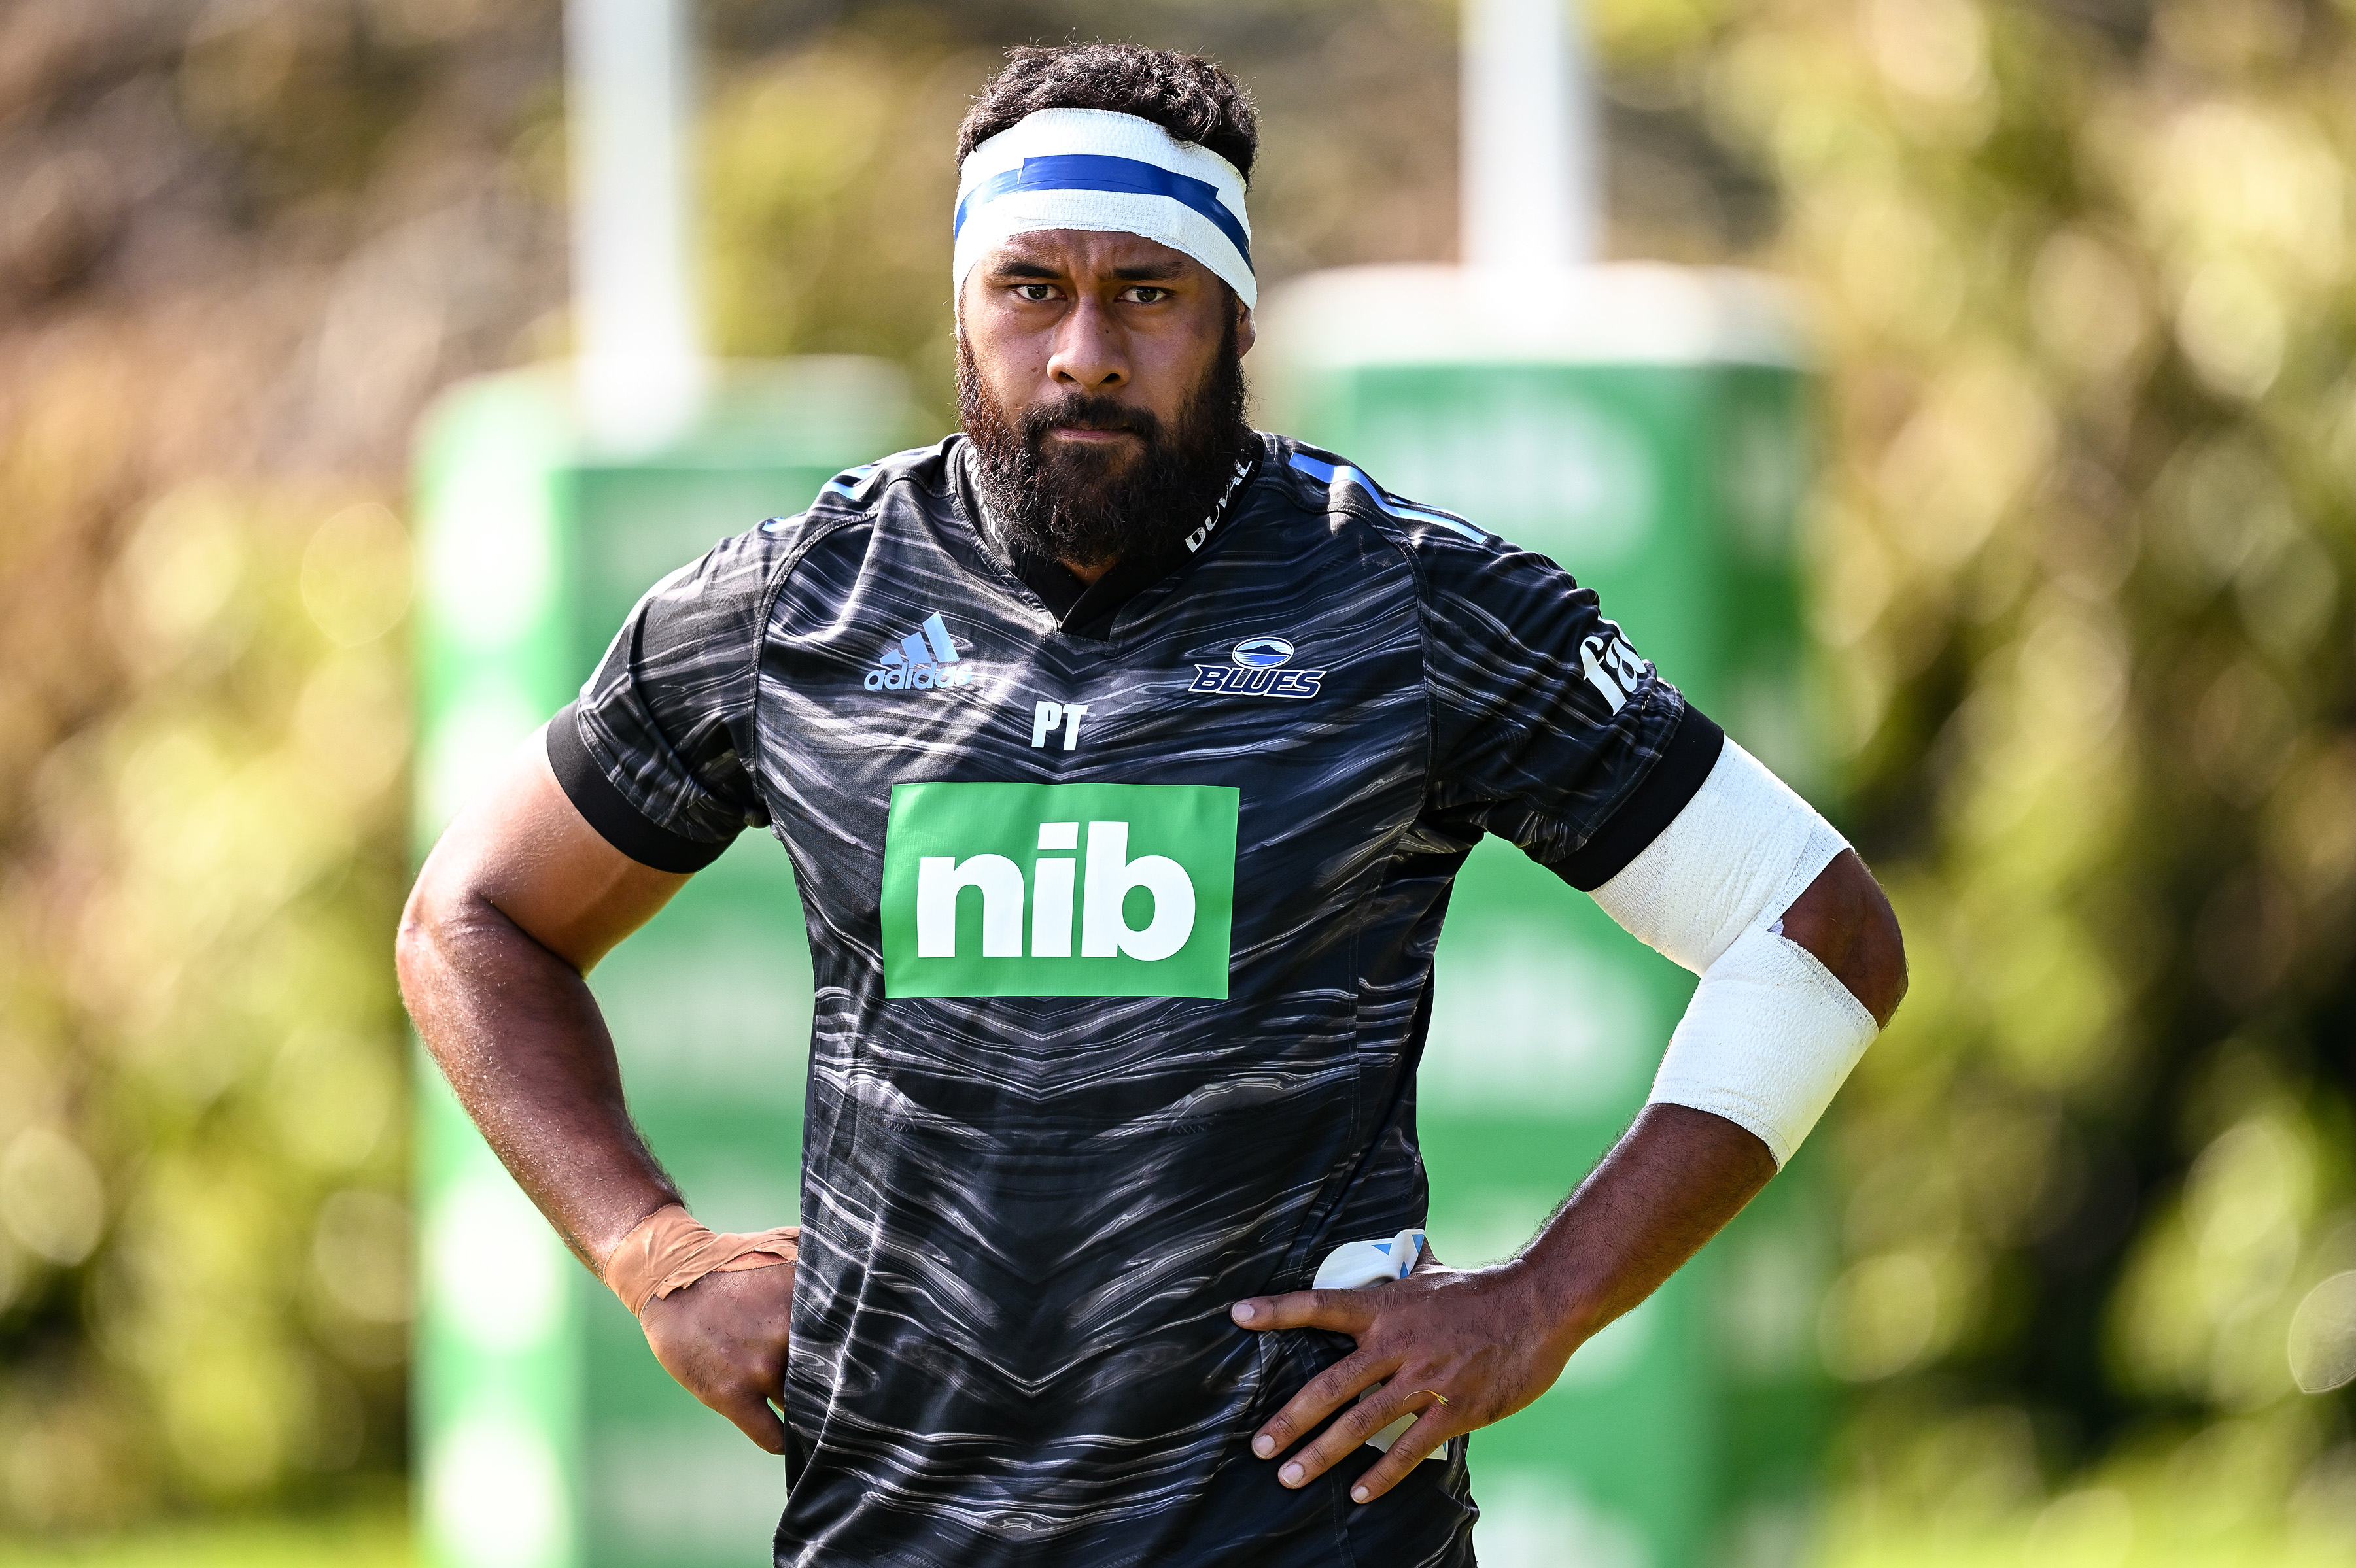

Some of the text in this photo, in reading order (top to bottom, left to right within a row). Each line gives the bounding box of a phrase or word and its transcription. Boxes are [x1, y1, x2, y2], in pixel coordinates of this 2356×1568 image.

[864, 662, 973, 691] adidas
[1187, 664, 1328, 699] BLUES
[1578, 613, 1647, 717] fa
[1031, 700, 1088, 751] PT
[916, 821, 1196, 961] nib
